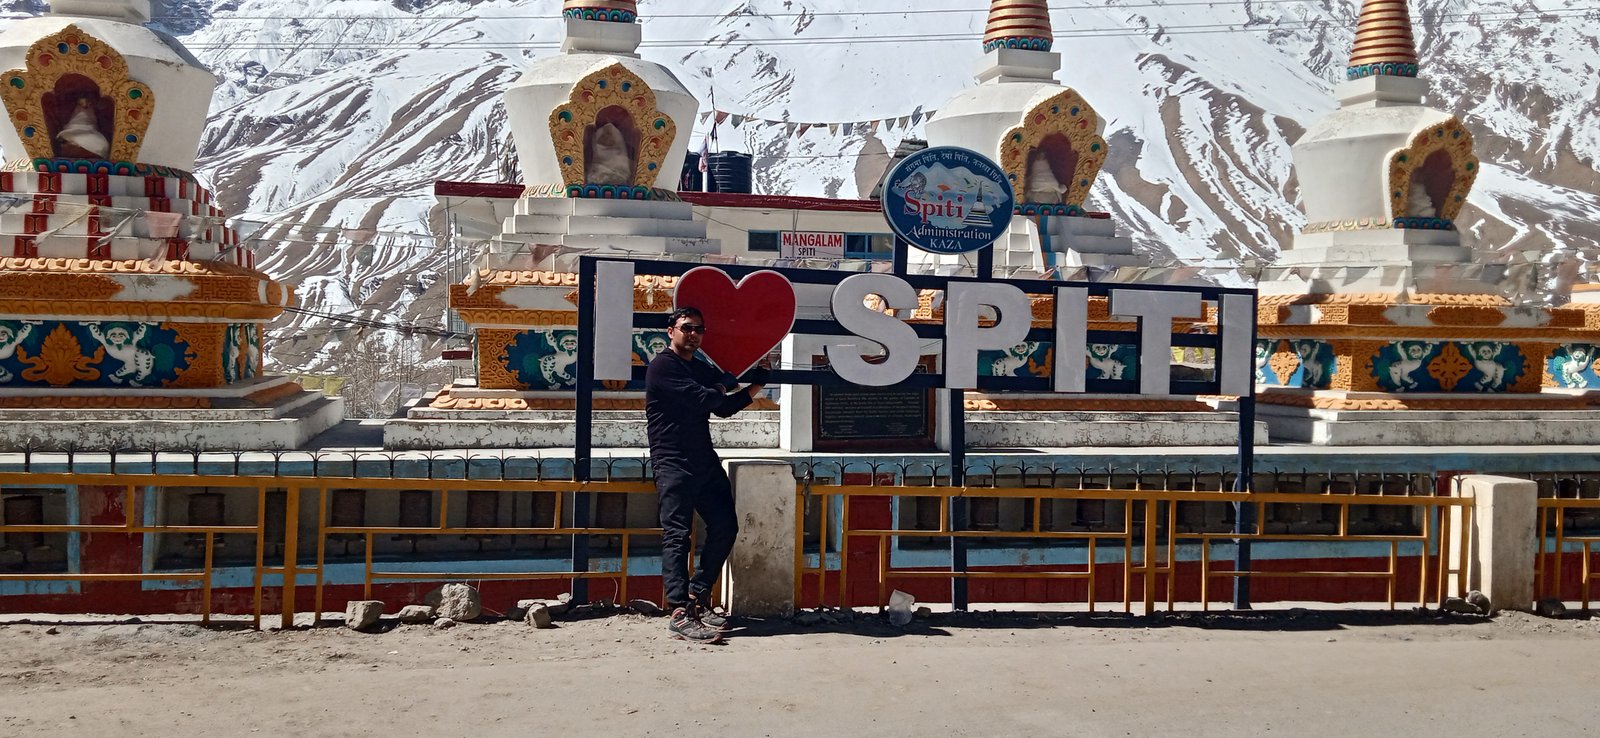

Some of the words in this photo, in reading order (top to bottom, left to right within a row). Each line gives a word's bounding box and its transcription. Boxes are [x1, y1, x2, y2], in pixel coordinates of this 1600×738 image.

[904, 190, 964, 224] Spiti
[906, 225, 991, 240] Administration
[783, 233, 842, 247] MANGALAM
[930, 238, 962, 250] KAZA
[798, 247, 816, 256] SPITI
[594, 261, 635, 381] I
[826, 273, 1252, 397] SPITI
